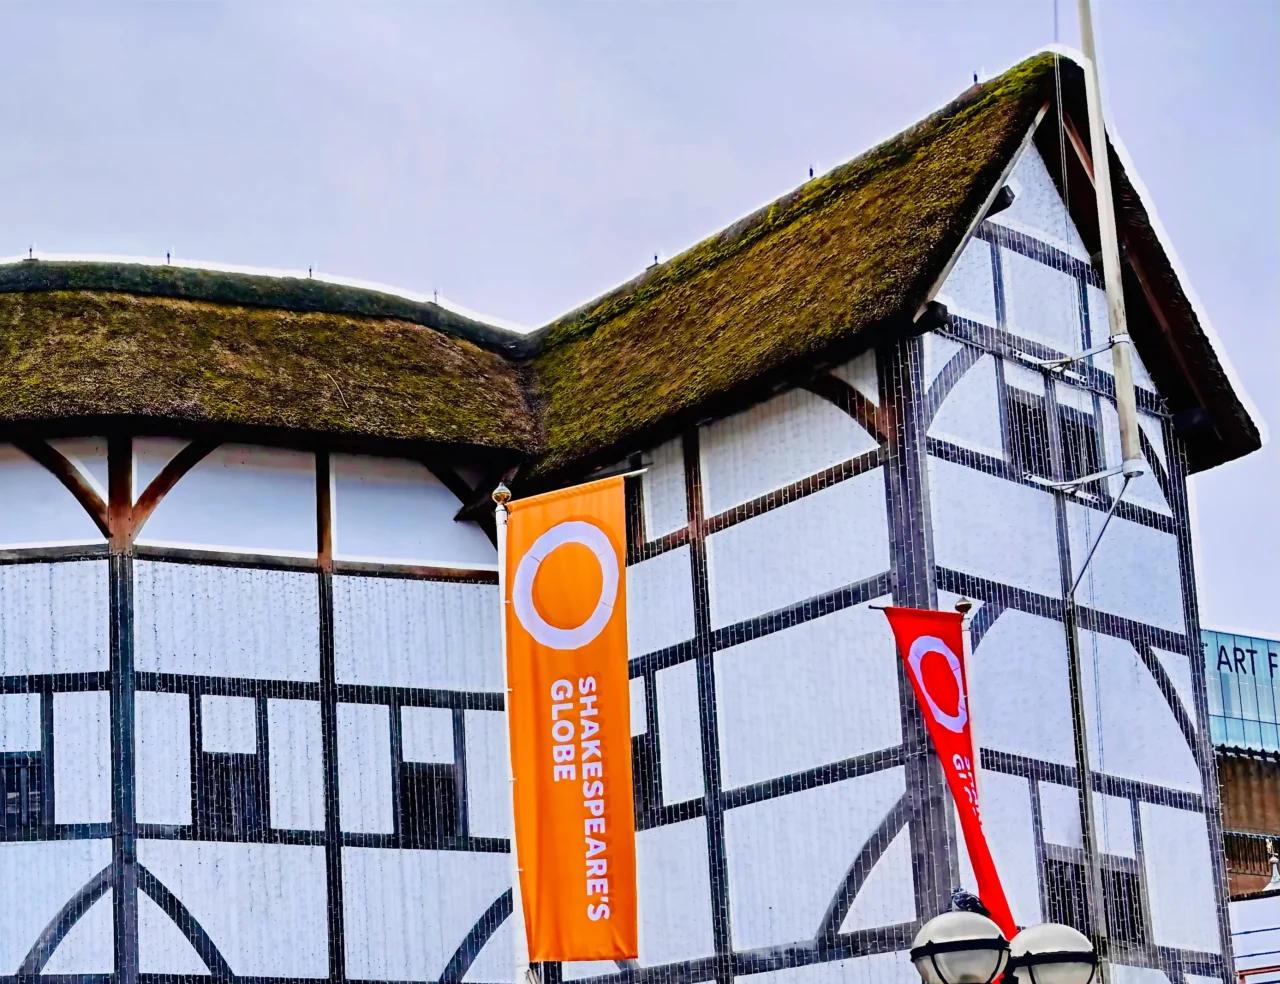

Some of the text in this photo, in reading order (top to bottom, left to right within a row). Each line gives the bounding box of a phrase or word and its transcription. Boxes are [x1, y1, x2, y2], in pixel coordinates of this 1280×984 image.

[1217, 645, 1258, 675] ART
[550, 678, 576, 782] GLOBE
[578, 676, 610, 921] SHAKESPEARE'S
